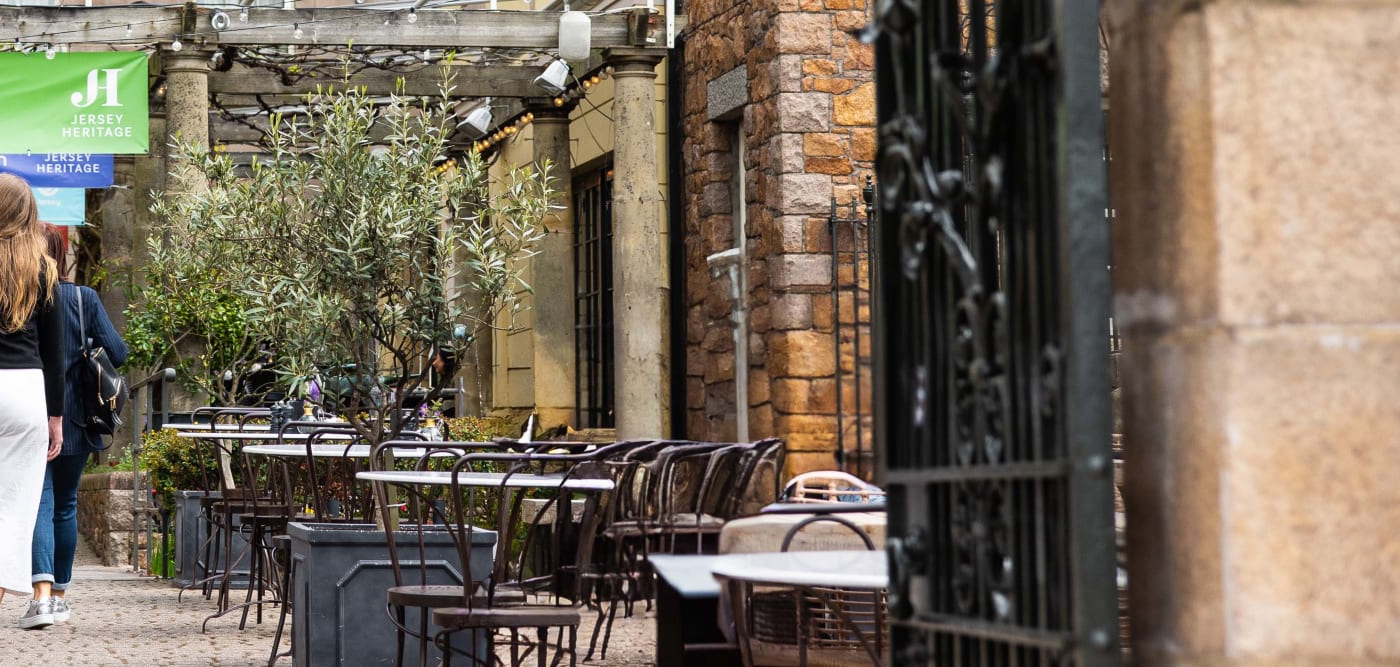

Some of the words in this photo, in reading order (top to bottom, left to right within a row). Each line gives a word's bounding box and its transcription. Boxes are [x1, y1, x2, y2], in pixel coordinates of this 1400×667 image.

[71, 113, 124, 125] JERSEY
[62, 126, 133, 138] HERITAGE
[44, 153, 92, 162] JERSEY
[36, 163, 100, 173] HERITAGE
